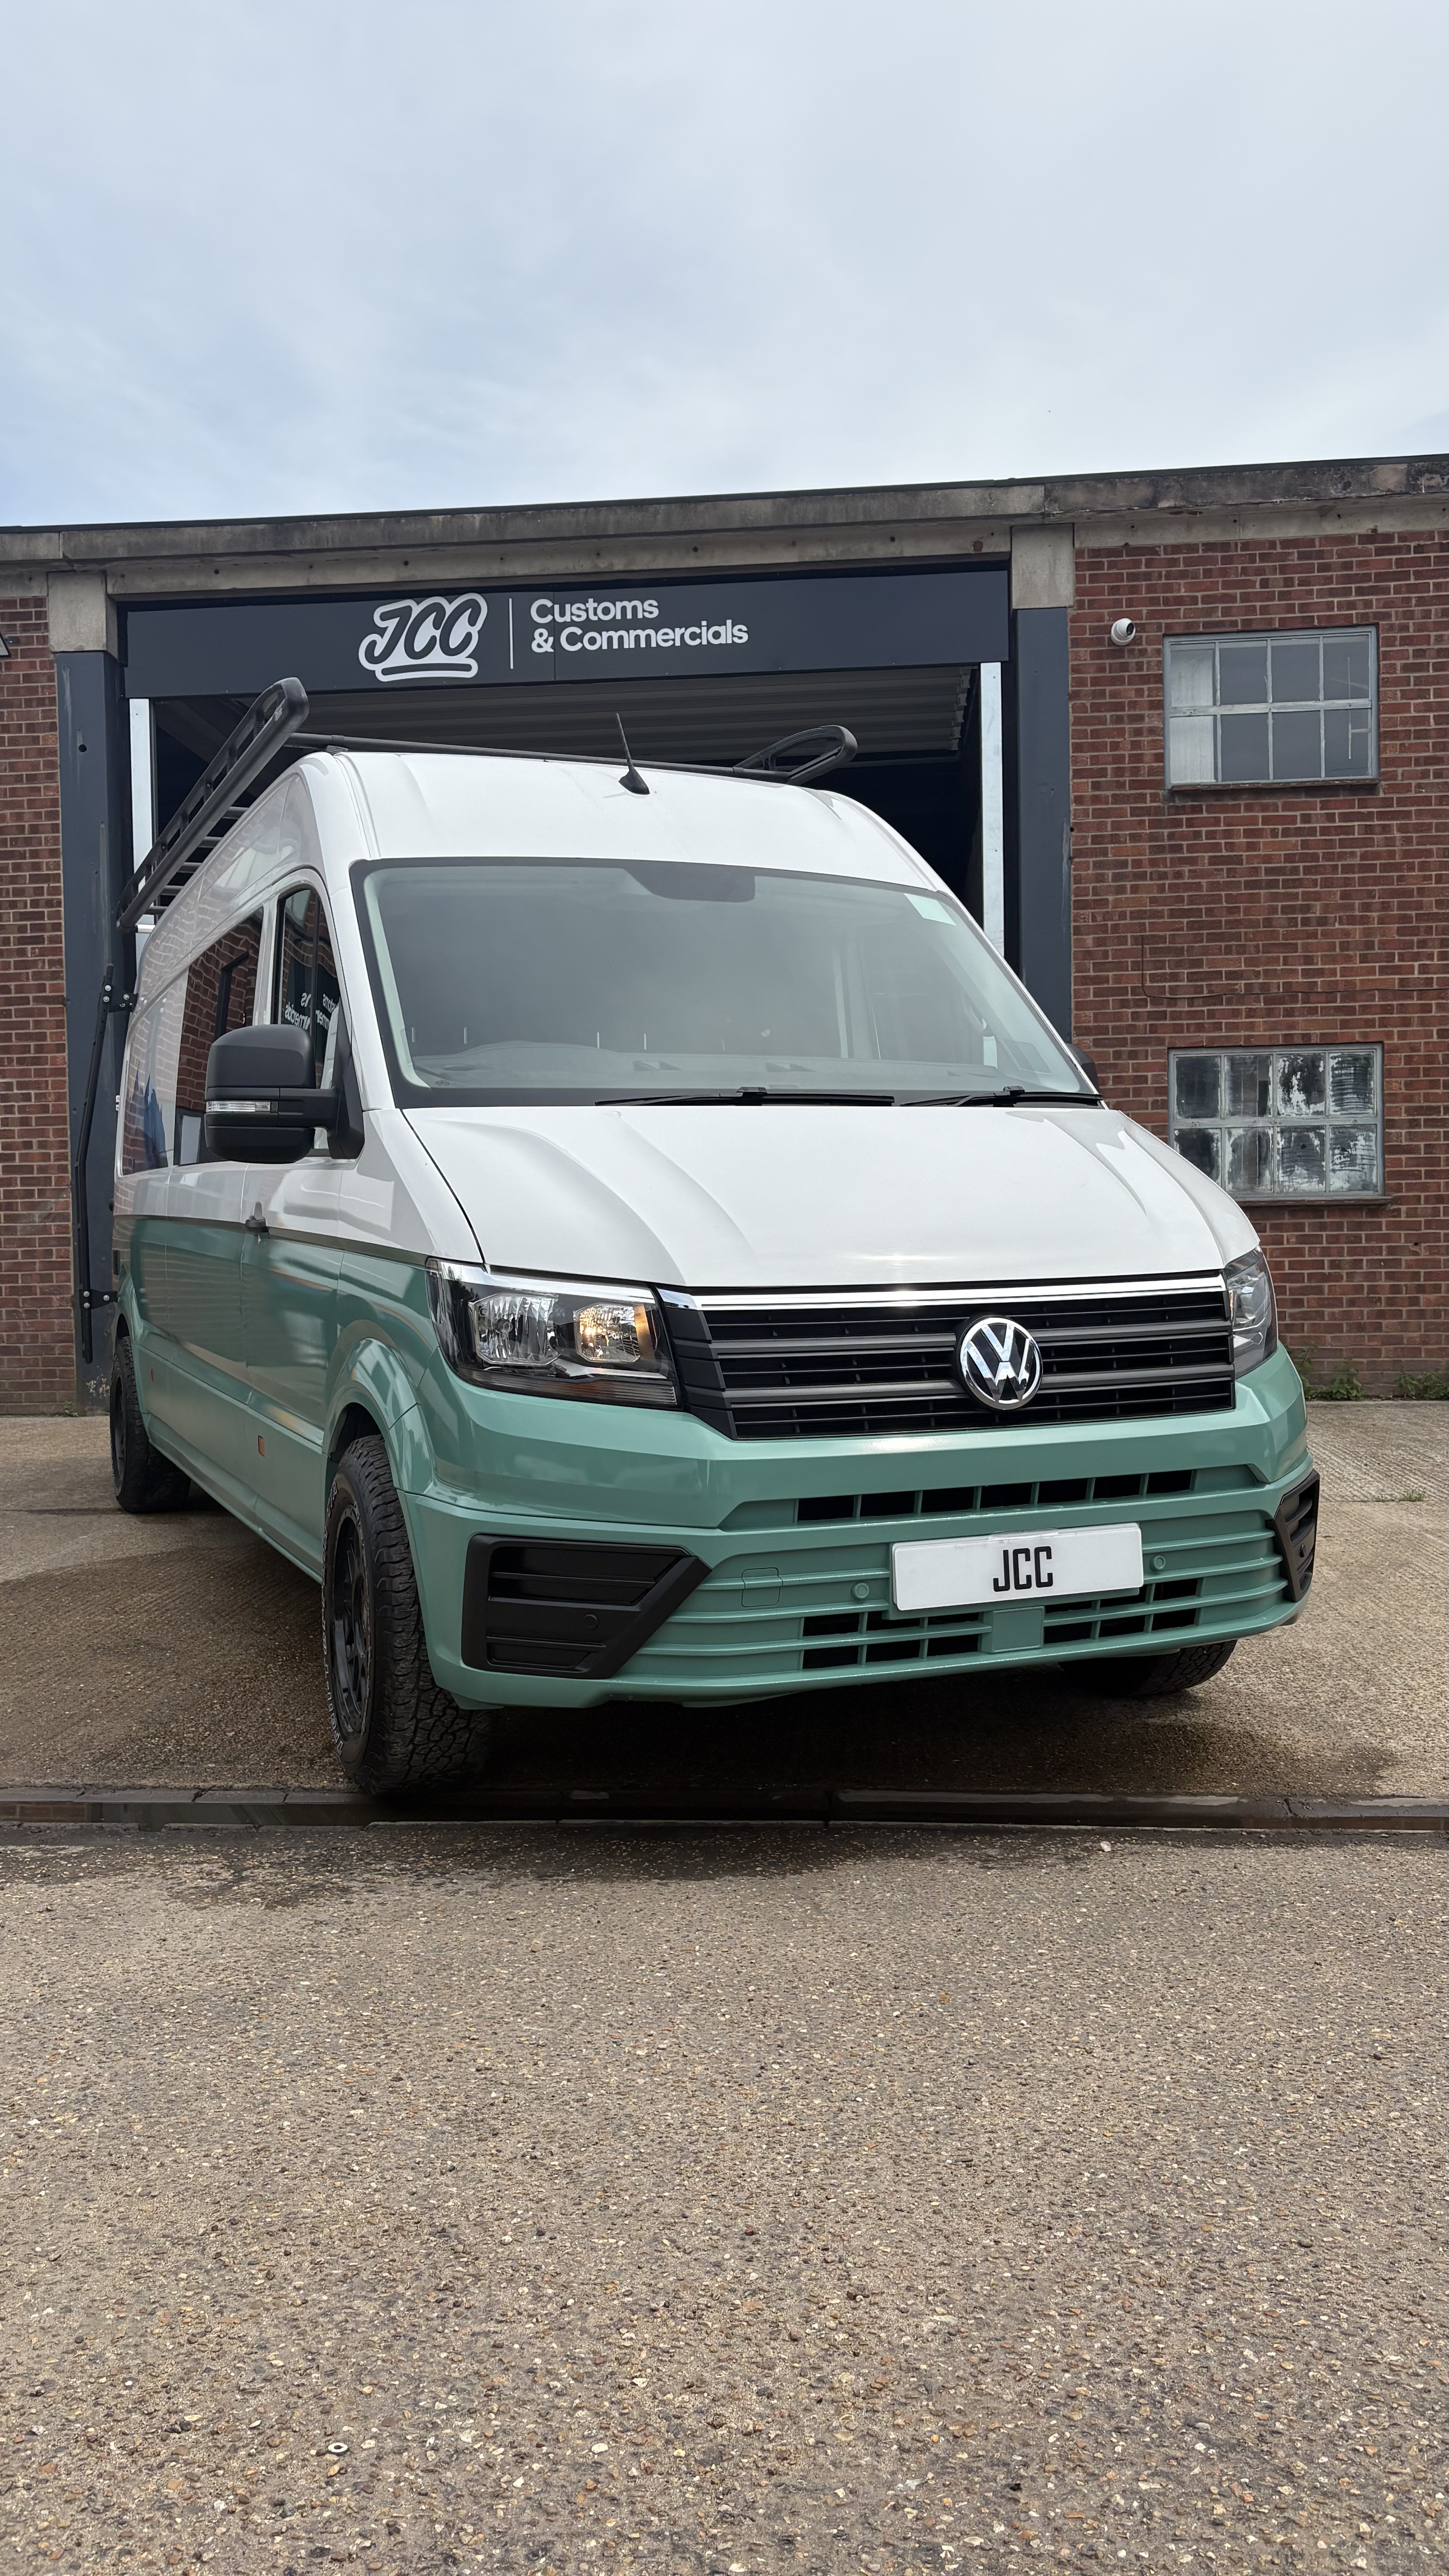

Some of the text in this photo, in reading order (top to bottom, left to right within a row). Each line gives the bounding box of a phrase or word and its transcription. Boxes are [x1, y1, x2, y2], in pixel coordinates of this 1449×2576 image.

[531, 598, 658, 623] Customs
[359, 593, 487, 672] JCC
[531, 620, 749, 653] & Commercials
[993, 1546, 1053, 1592] JCC
